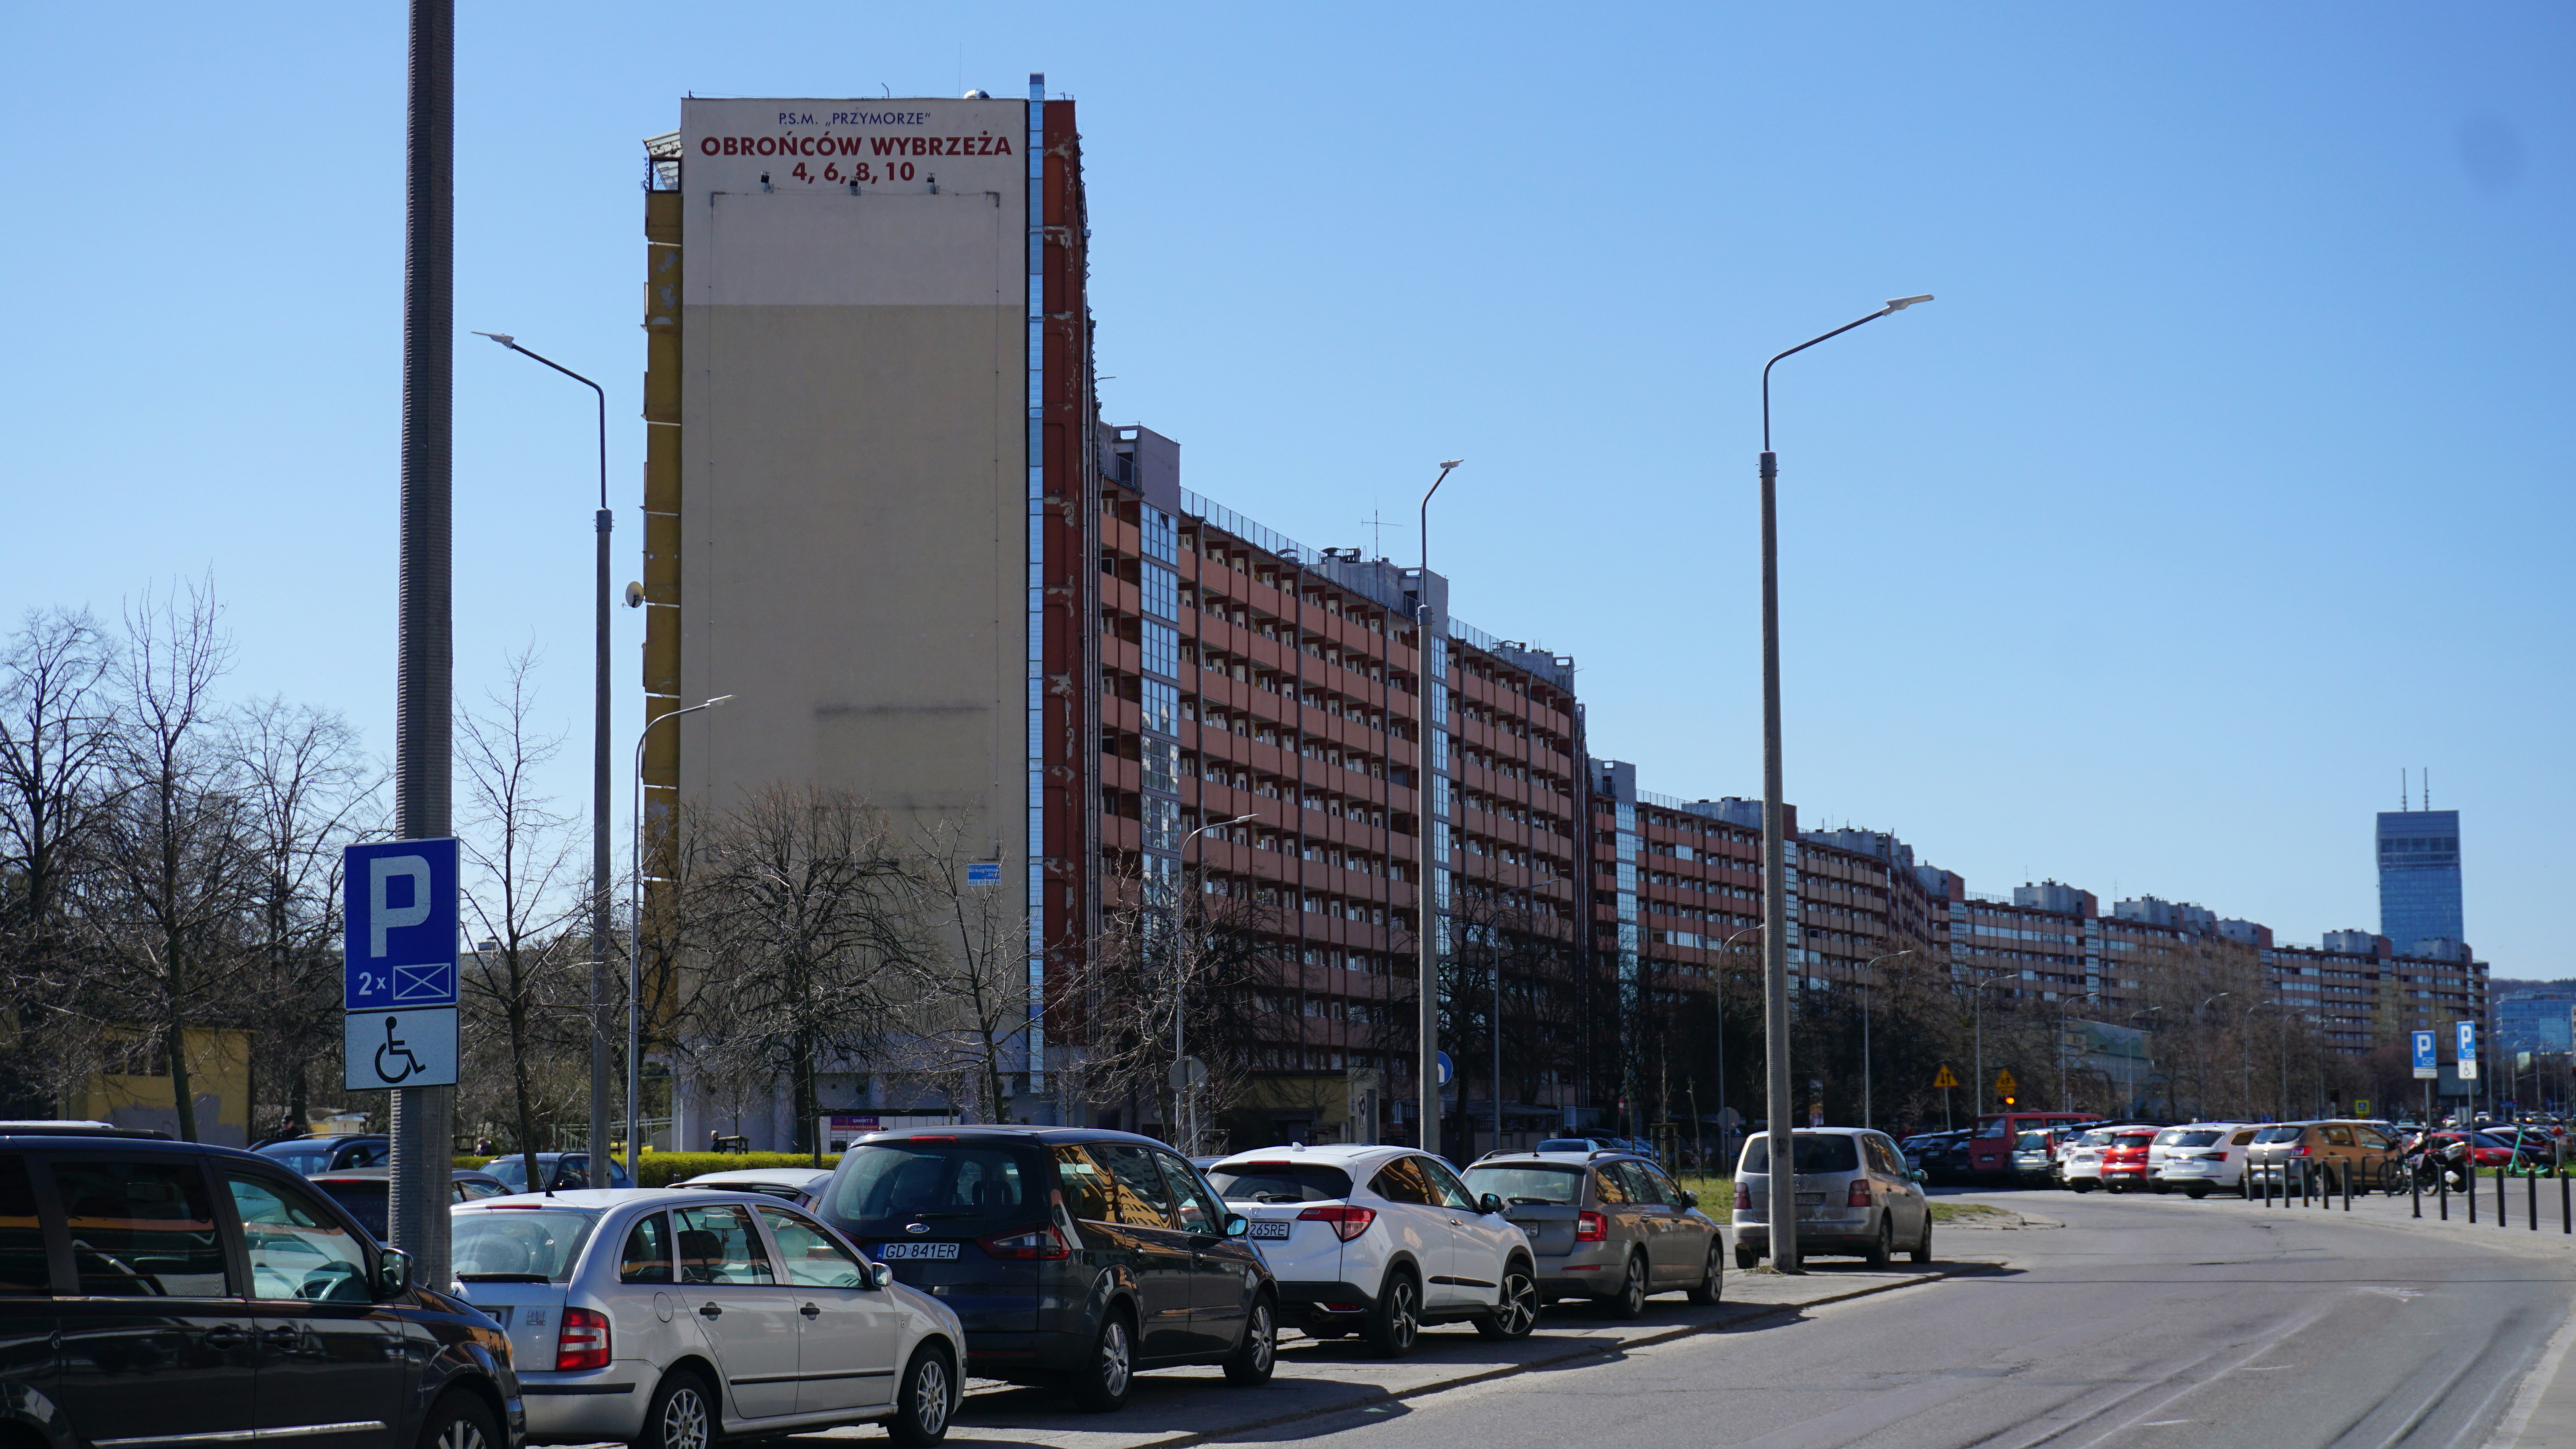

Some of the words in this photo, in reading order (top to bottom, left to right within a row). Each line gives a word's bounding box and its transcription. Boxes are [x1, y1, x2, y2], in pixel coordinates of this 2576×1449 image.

[779, 112, 818, 124] P.S.M.
[701, 131, 862, 156] OBROŃCÓW
[870, 130, 1012, 156] WYBRZEŻA
[792, 162, 815, 184] 4,
[824, 162, 846, 184] 6,
[886, 162, 915, 181] 10
[370, 855, 431, 958] P
[2417, 1034, 2431, 1058] P
[2460, 1025, 2472, 1049] P
[1249, 1224, 1285, 1236] 265RE
[886, 1244, 907, 1258] GD
[911, 1244, 957, 1258] 841ER
